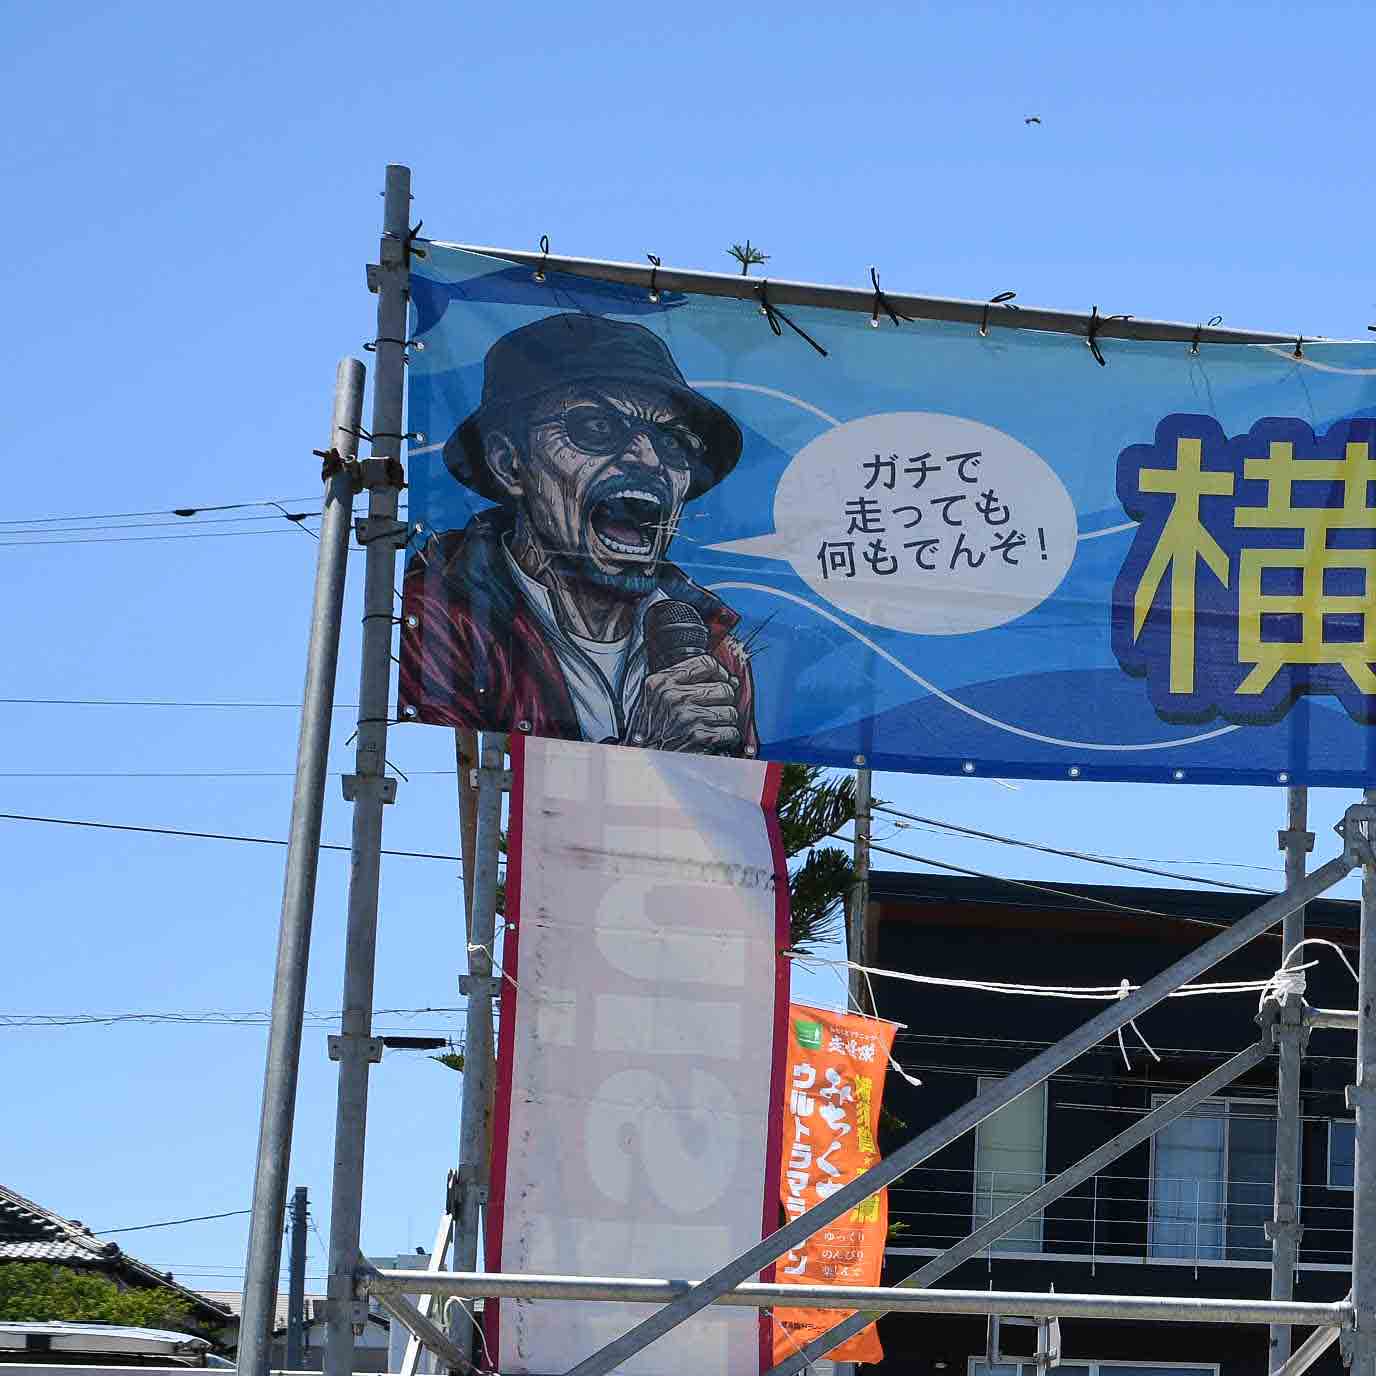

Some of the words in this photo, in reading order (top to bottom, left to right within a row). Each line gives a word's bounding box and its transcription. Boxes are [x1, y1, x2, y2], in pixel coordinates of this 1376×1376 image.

[863, 447, 981, 489] ガチで
[844, 487, 1012, 534] 走っても
